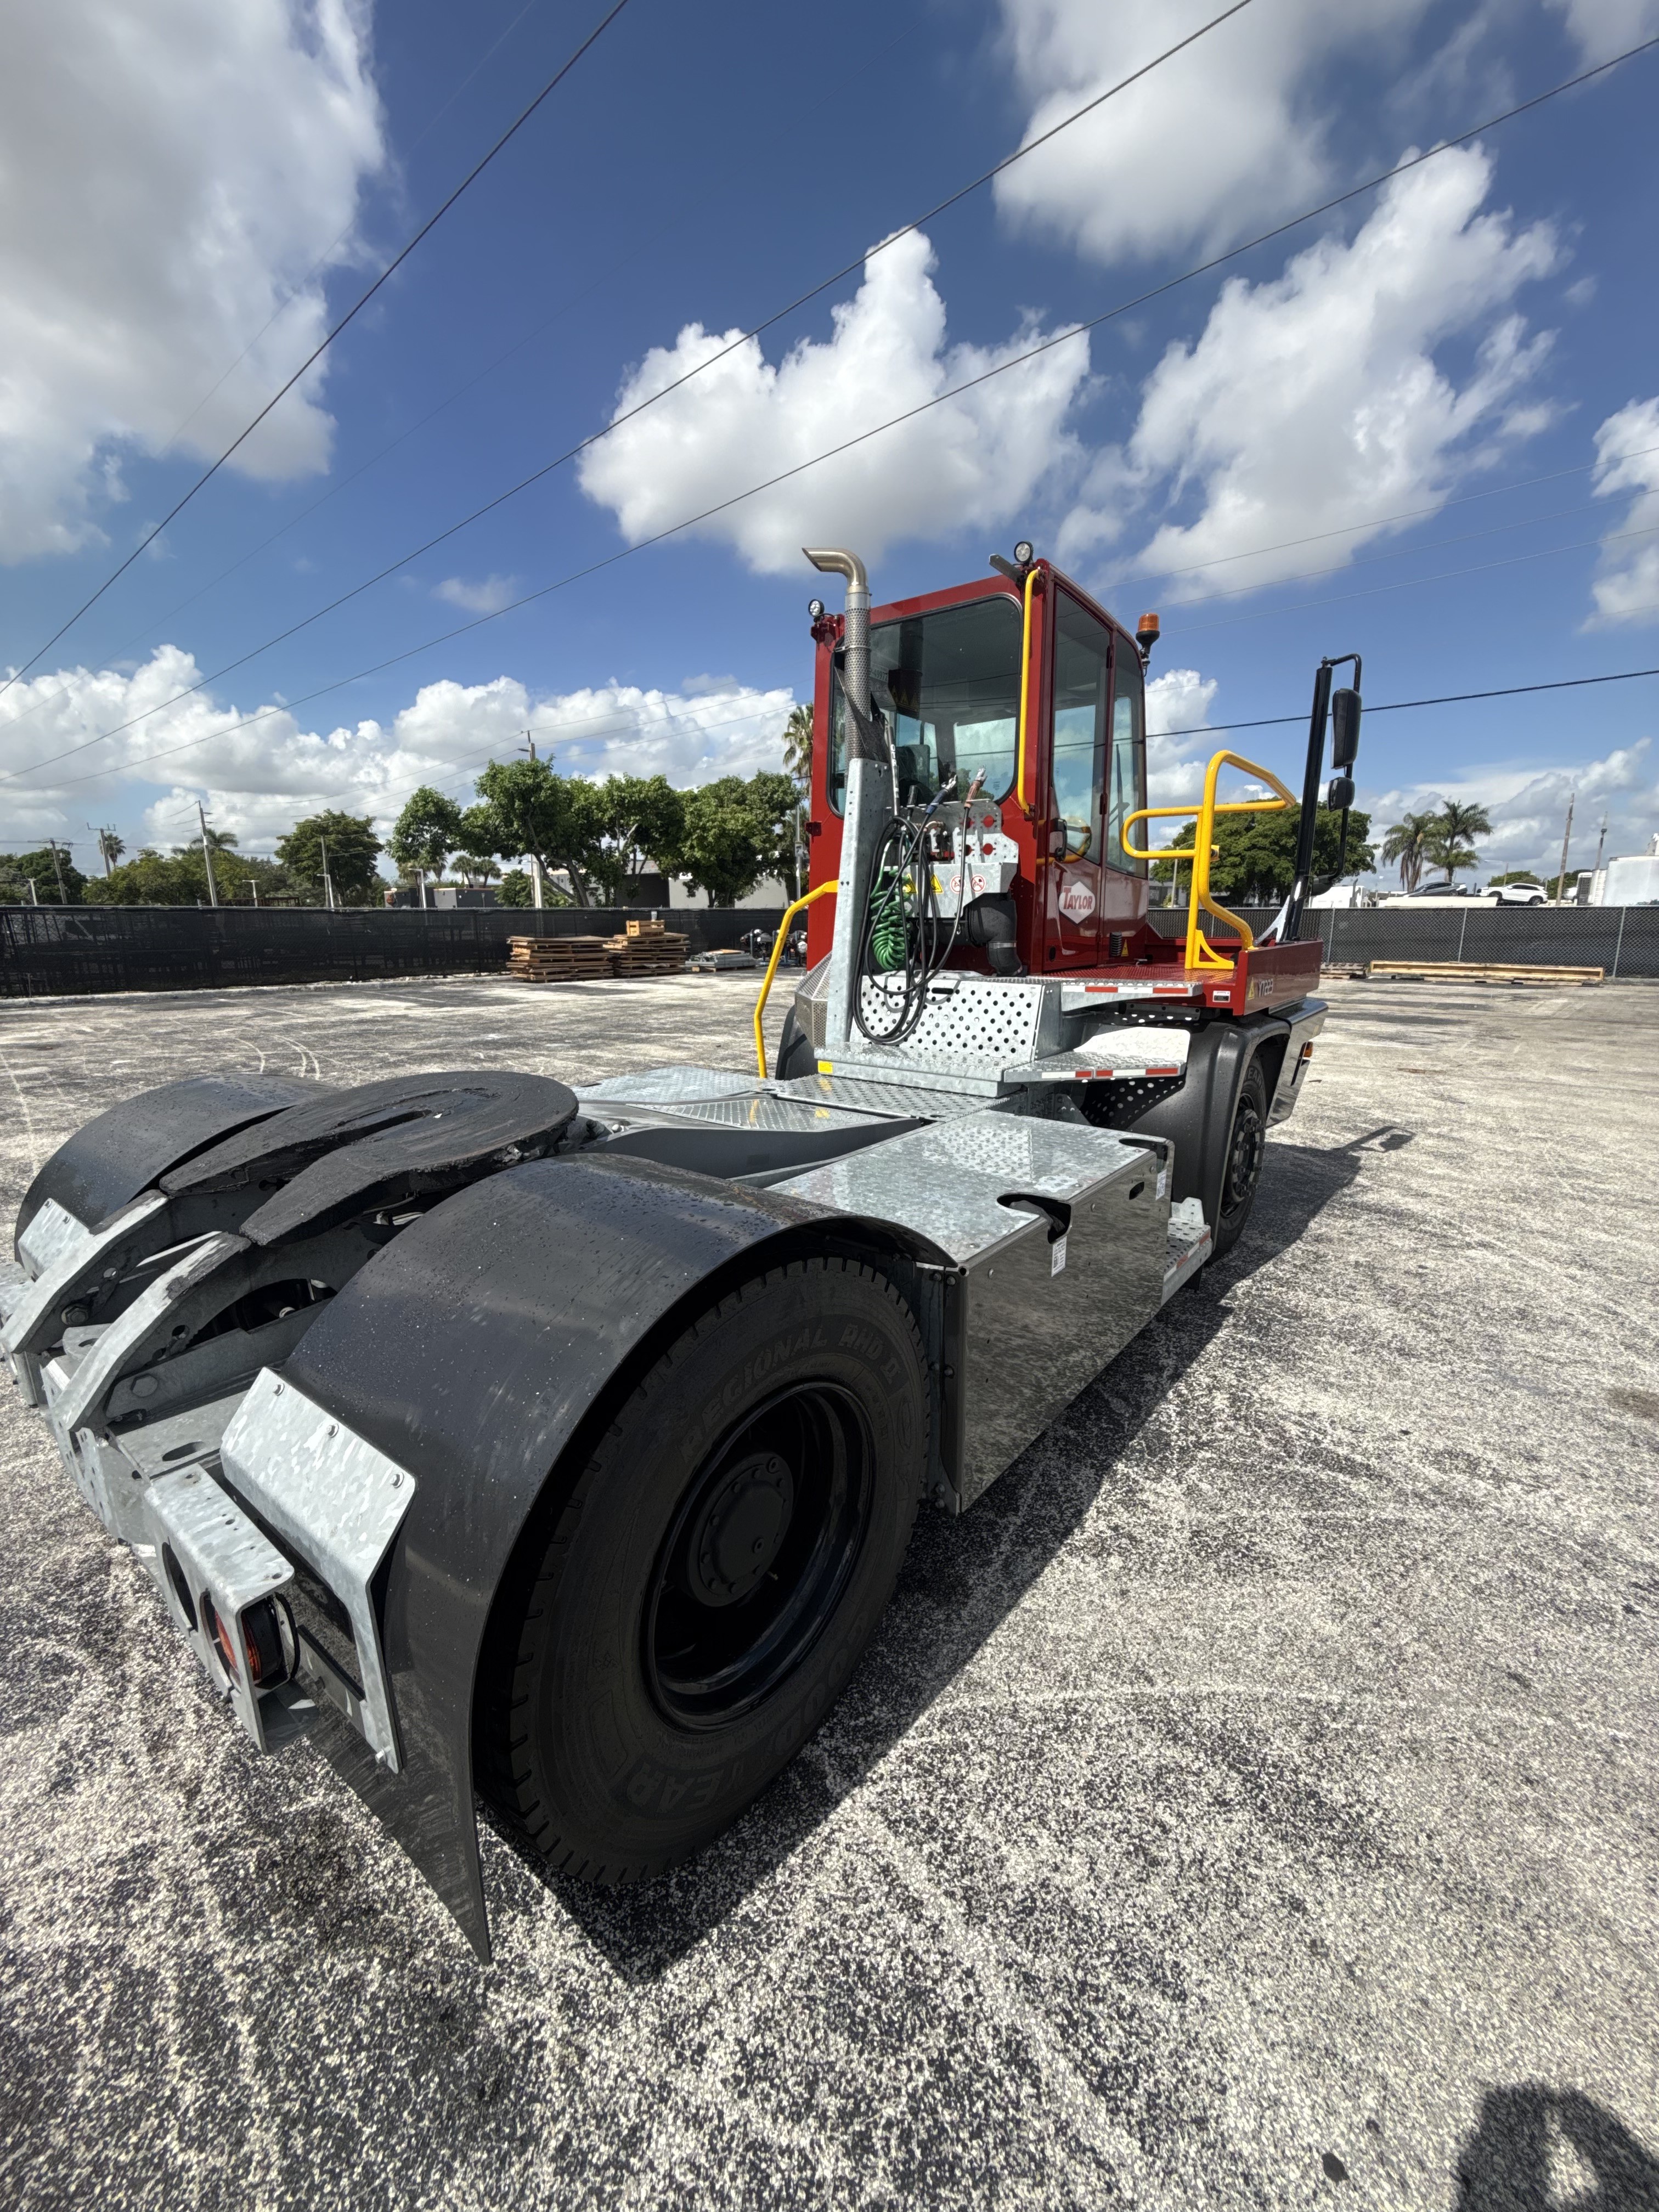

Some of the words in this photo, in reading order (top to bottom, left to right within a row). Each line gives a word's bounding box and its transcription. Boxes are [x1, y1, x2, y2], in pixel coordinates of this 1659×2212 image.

[1062, 886, 1093, 910] TAYLOR
[1245, 1067, 1262, 1086] EAR
[680, 1325, 827, 1464] REGIONAL
[837, 1323, 884, 1361] RHD
